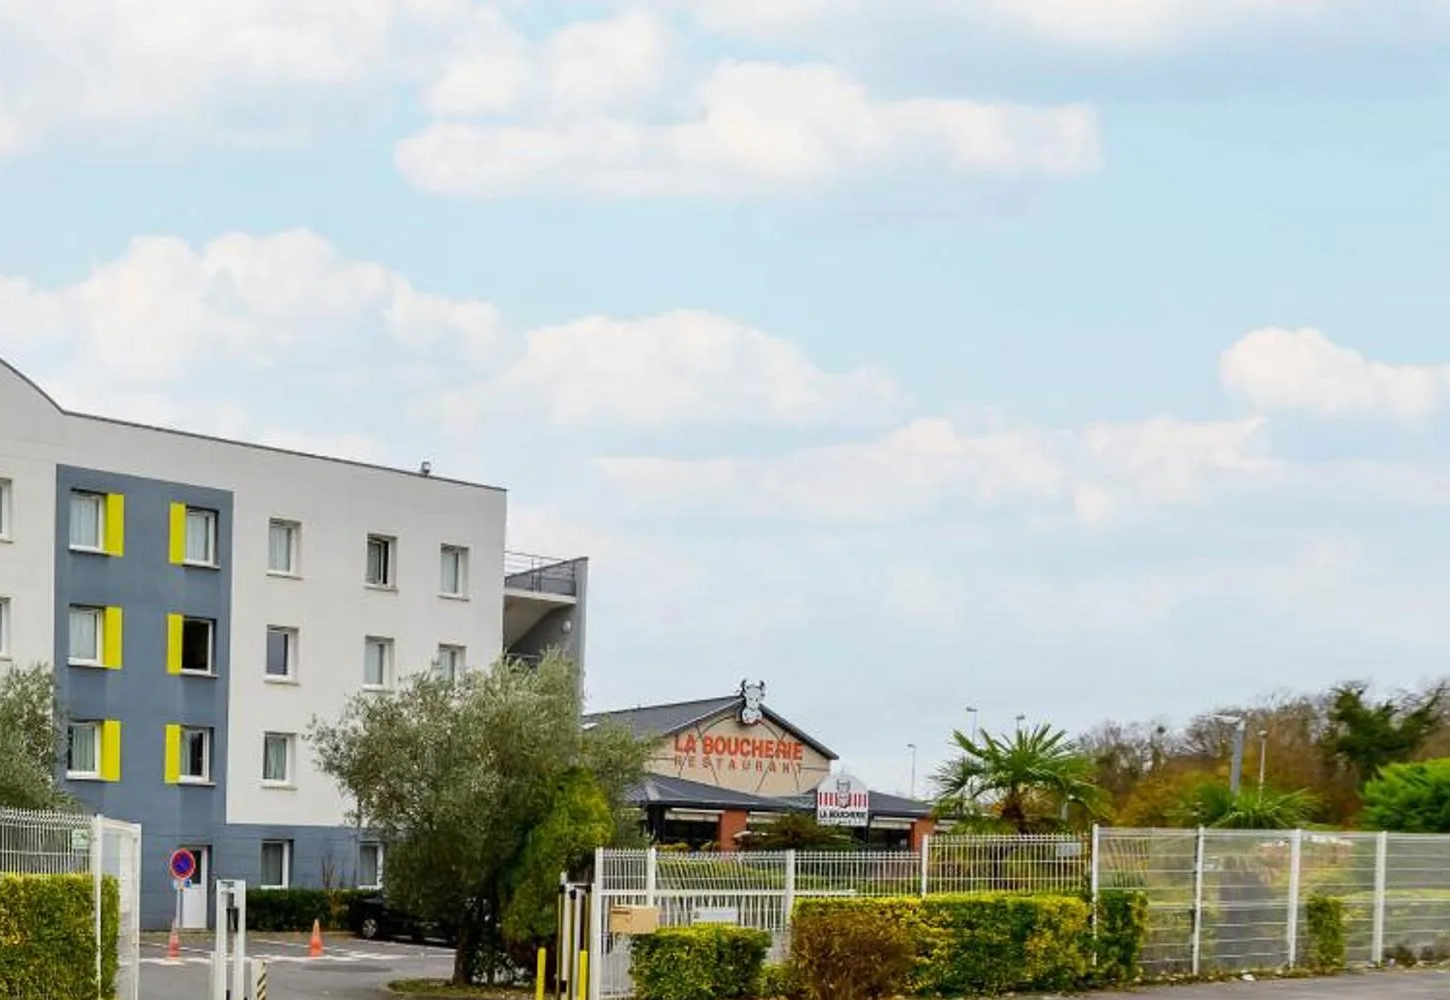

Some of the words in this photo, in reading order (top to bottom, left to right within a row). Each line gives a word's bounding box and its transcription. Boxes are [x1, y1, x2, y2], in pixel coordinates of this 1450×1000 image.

[674, 734, 696, 753] LA
[702, 736, 803, 760] BOUCHERIE
[674, 756, 802, 774] RESTAURANT
